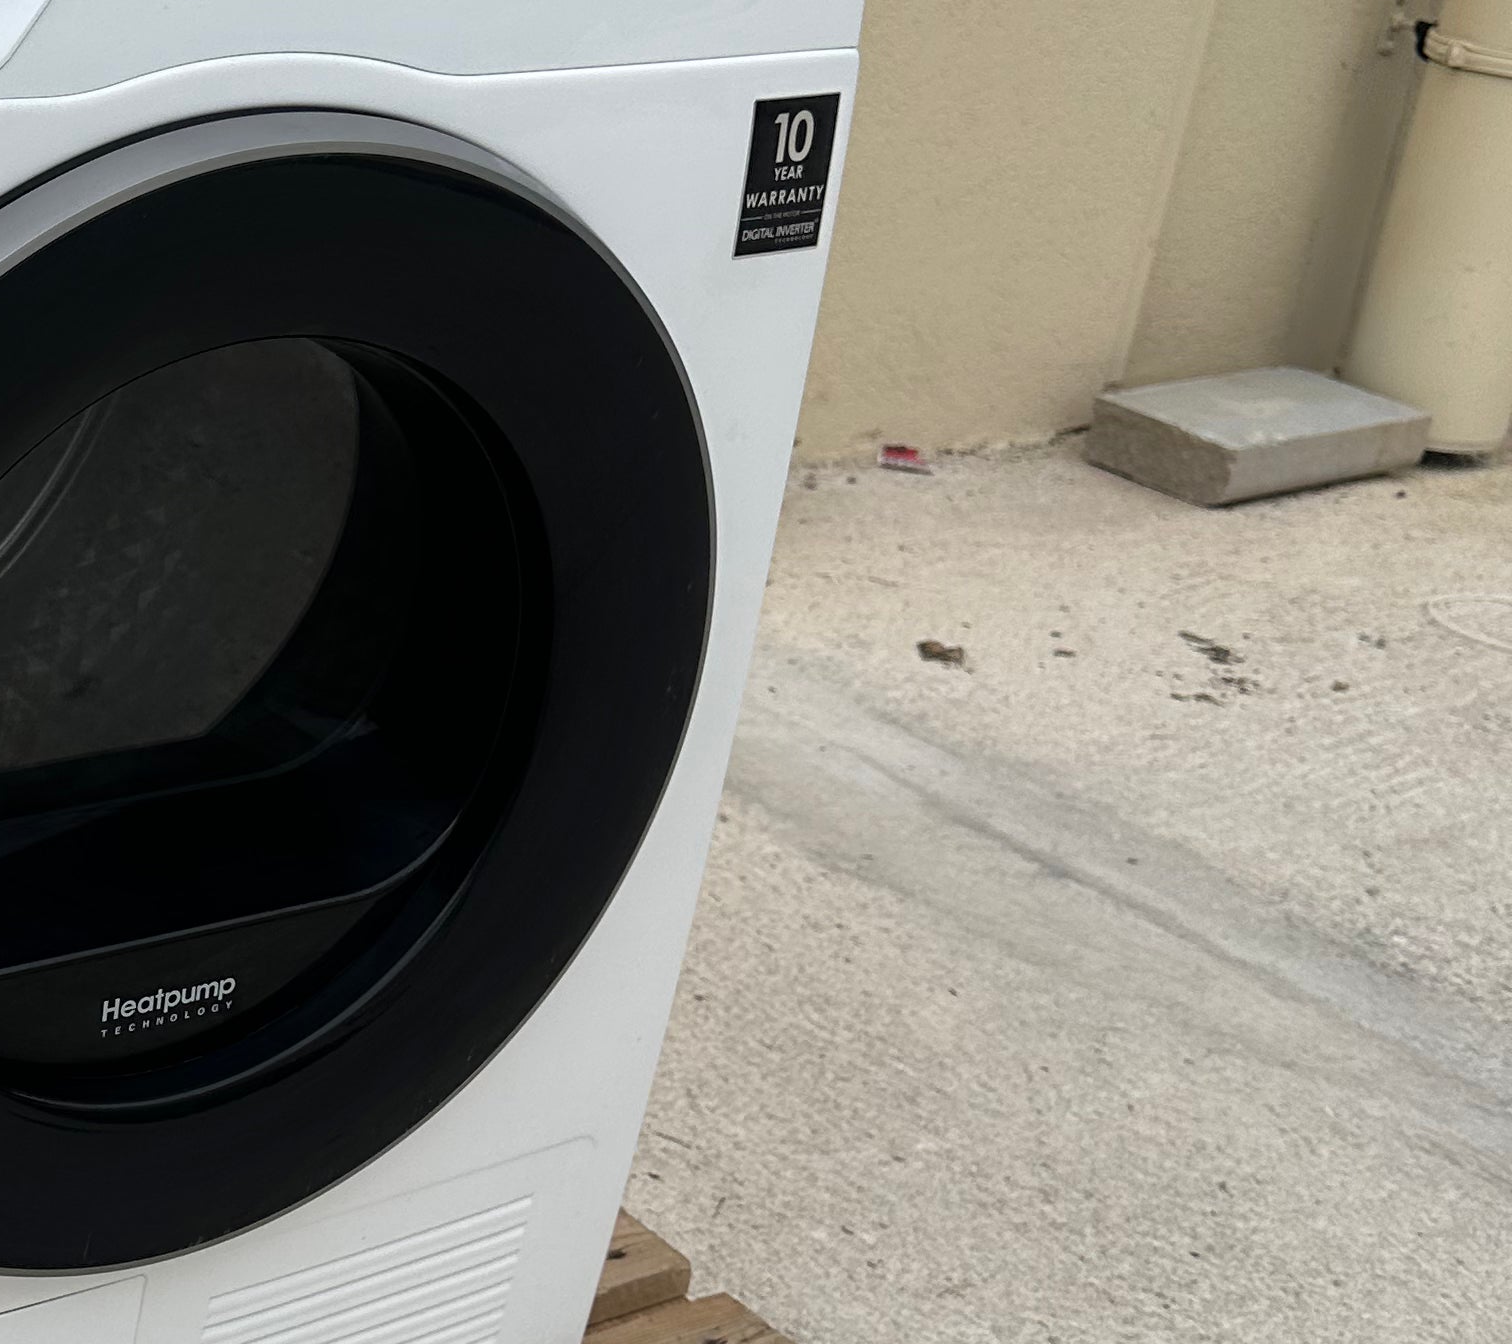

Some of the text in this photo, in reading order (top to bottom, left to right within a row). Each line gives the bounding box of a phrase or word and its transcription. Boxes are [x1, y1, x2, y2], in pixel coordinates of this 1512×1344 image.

[774, 110, 815, 163] 10
[774, 164, 804, 181] YEAR
[746, 184, 825, 209] WARRANTY
[741, 222, 816, 242] DIGITAL INVERTER
[101, 977, 236, 1022] Heatpump
[101, 1000, 233, 1038] TECHNOLOGY
